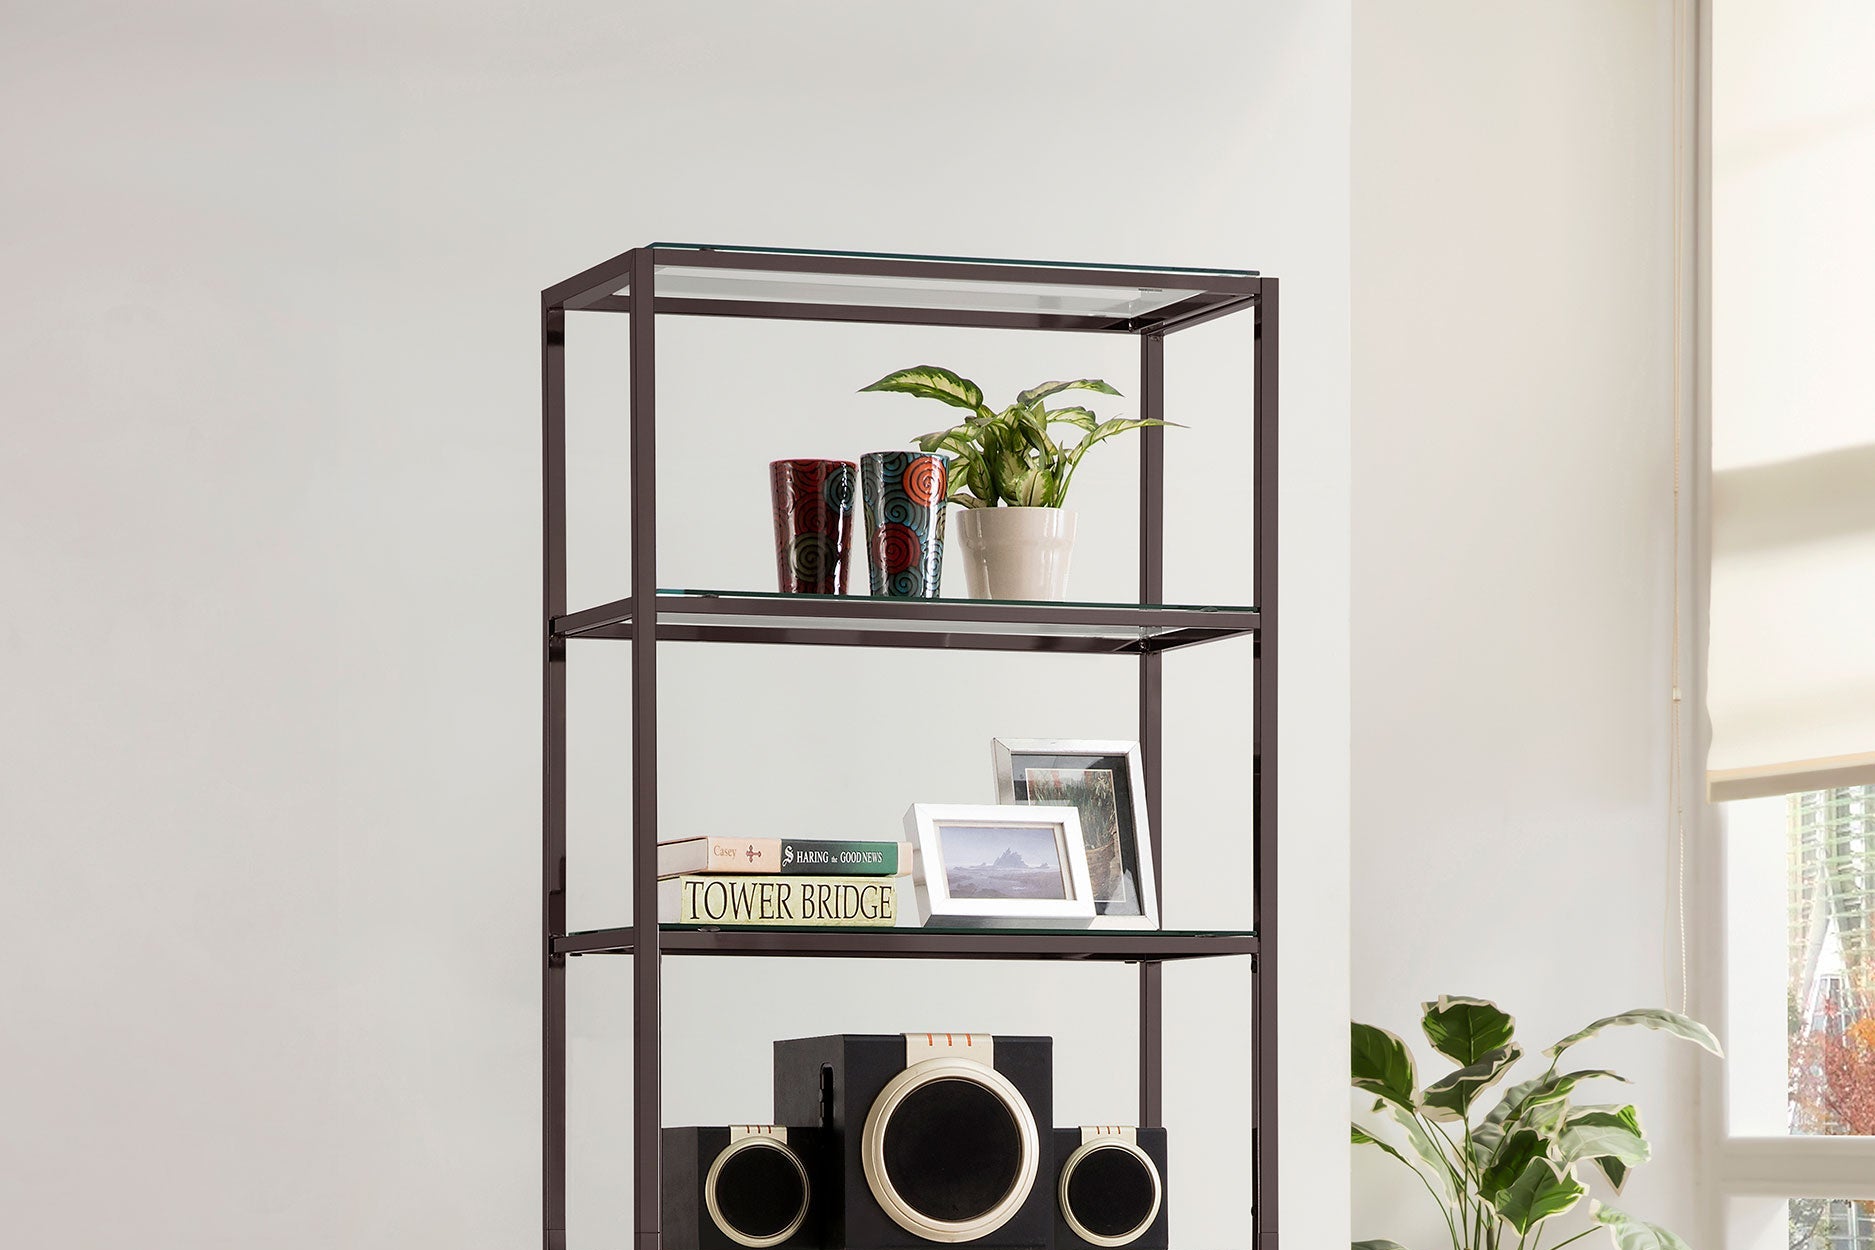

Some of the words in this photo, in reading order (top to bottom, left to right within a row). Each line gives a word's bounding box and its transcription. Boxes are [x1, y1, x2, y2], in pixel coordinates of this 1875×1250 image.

[713, 844, 737, 860] Casey
[685, 881, 794, 920] TOWER
[801, 884, 893, 919] BRIDGE
